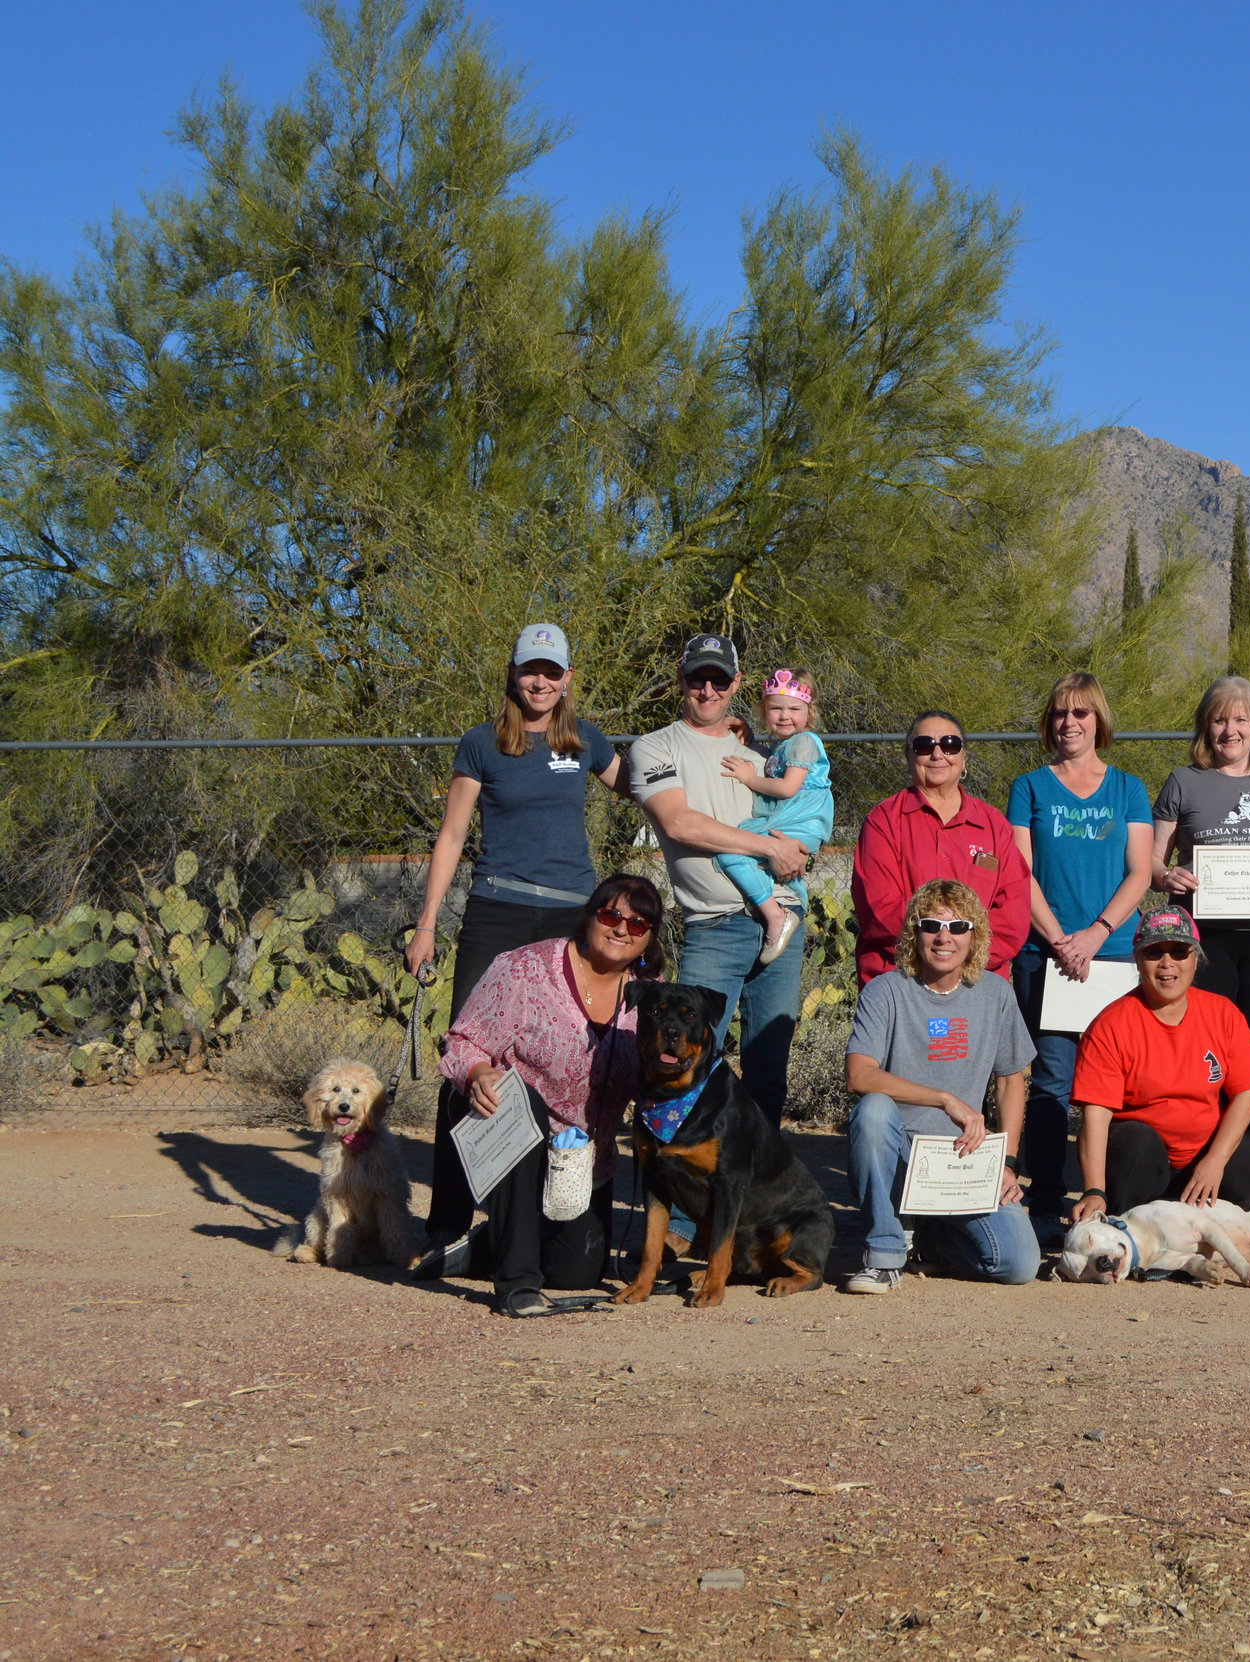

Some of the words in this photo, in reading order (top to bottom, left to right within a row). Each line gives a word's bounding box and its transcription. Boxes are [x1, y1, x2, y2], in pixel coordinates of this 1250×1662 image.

[1051, 805, 1114, 821] mama
[1053, 815, 1099, 840] bear
[1193, 827, 1239, 840] GERMAN
